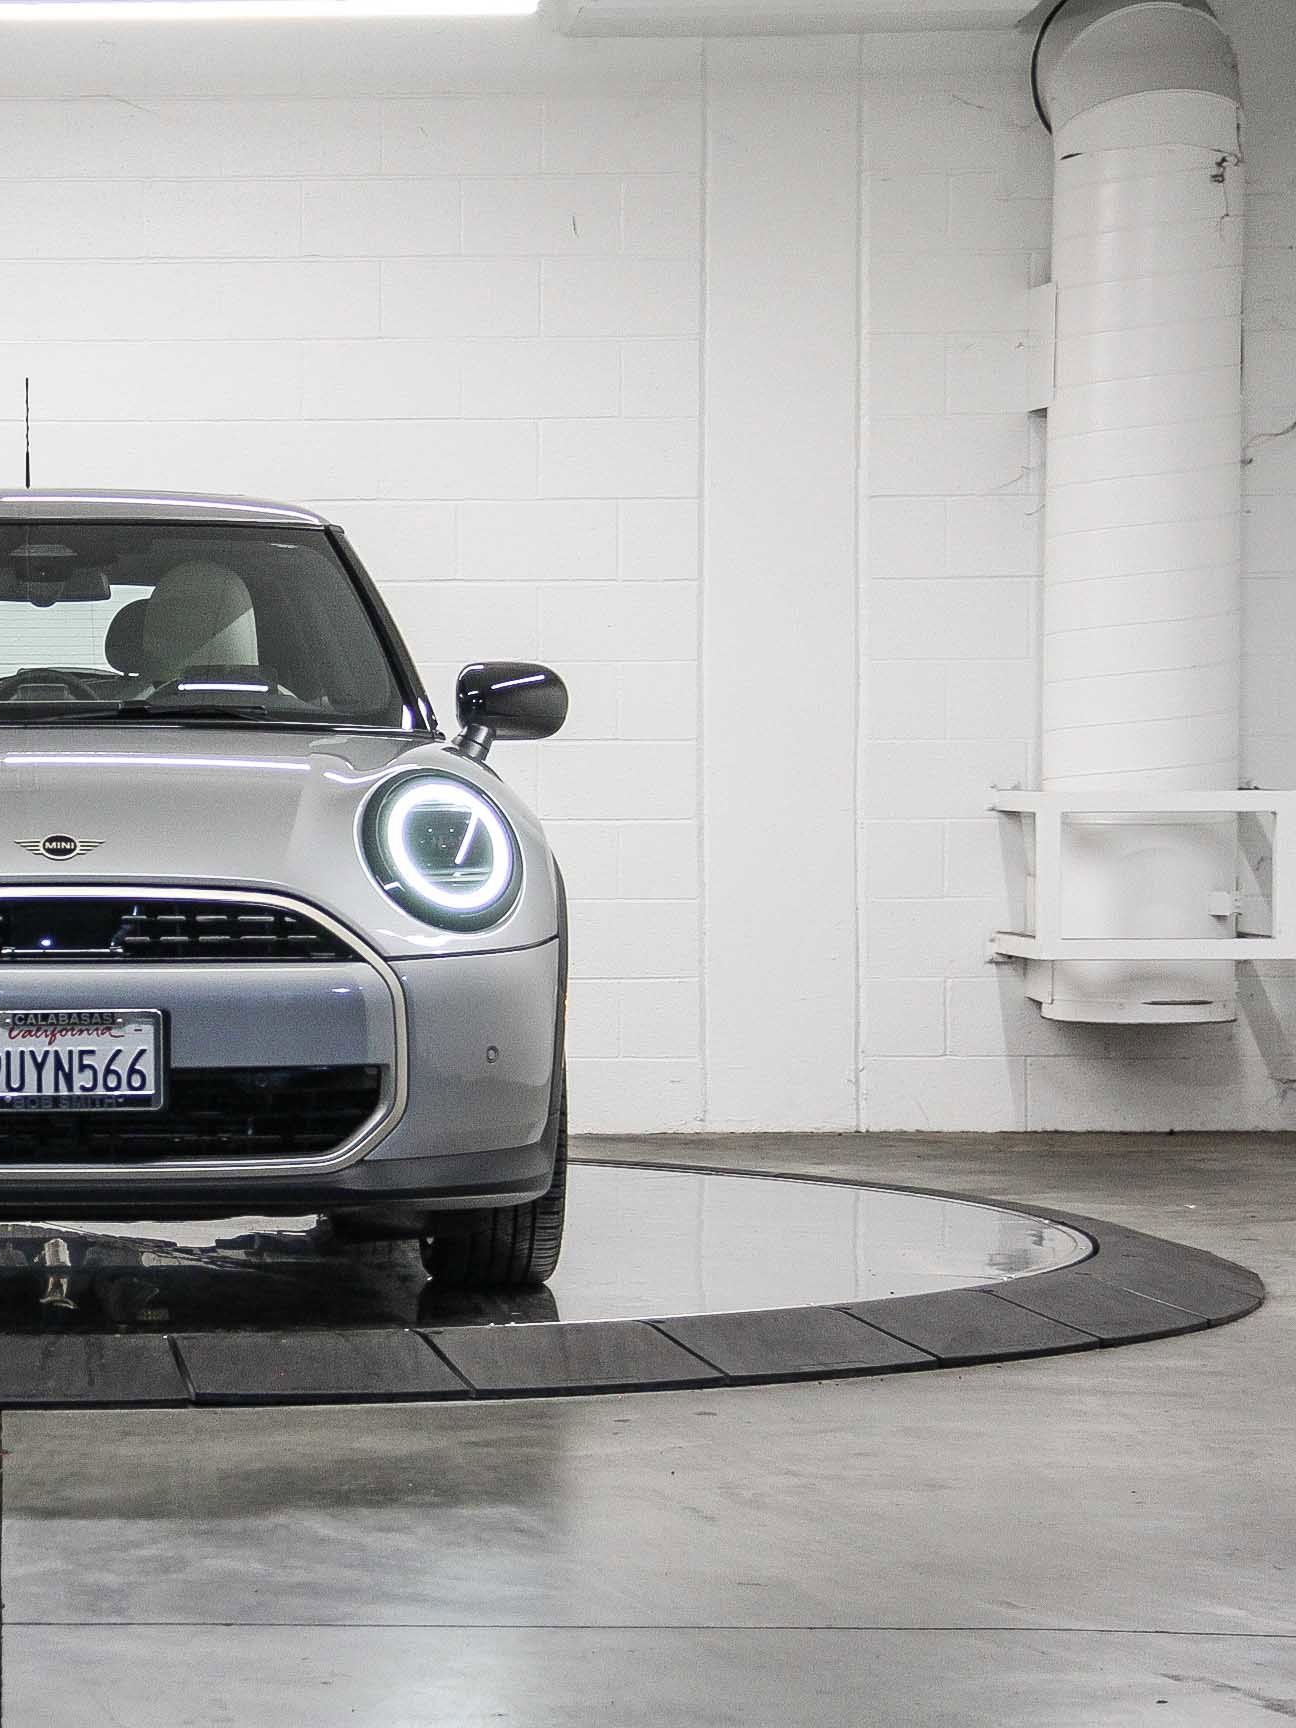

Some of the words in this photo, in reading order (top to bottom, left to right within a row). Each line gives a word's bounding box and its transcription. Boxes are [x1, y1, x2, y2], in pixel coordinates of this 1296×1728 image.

[44, 841, 75, 849] MINI
[15, 1014, 113, 1025] CALABASAS
[8, 1026, 125, 1046] California
